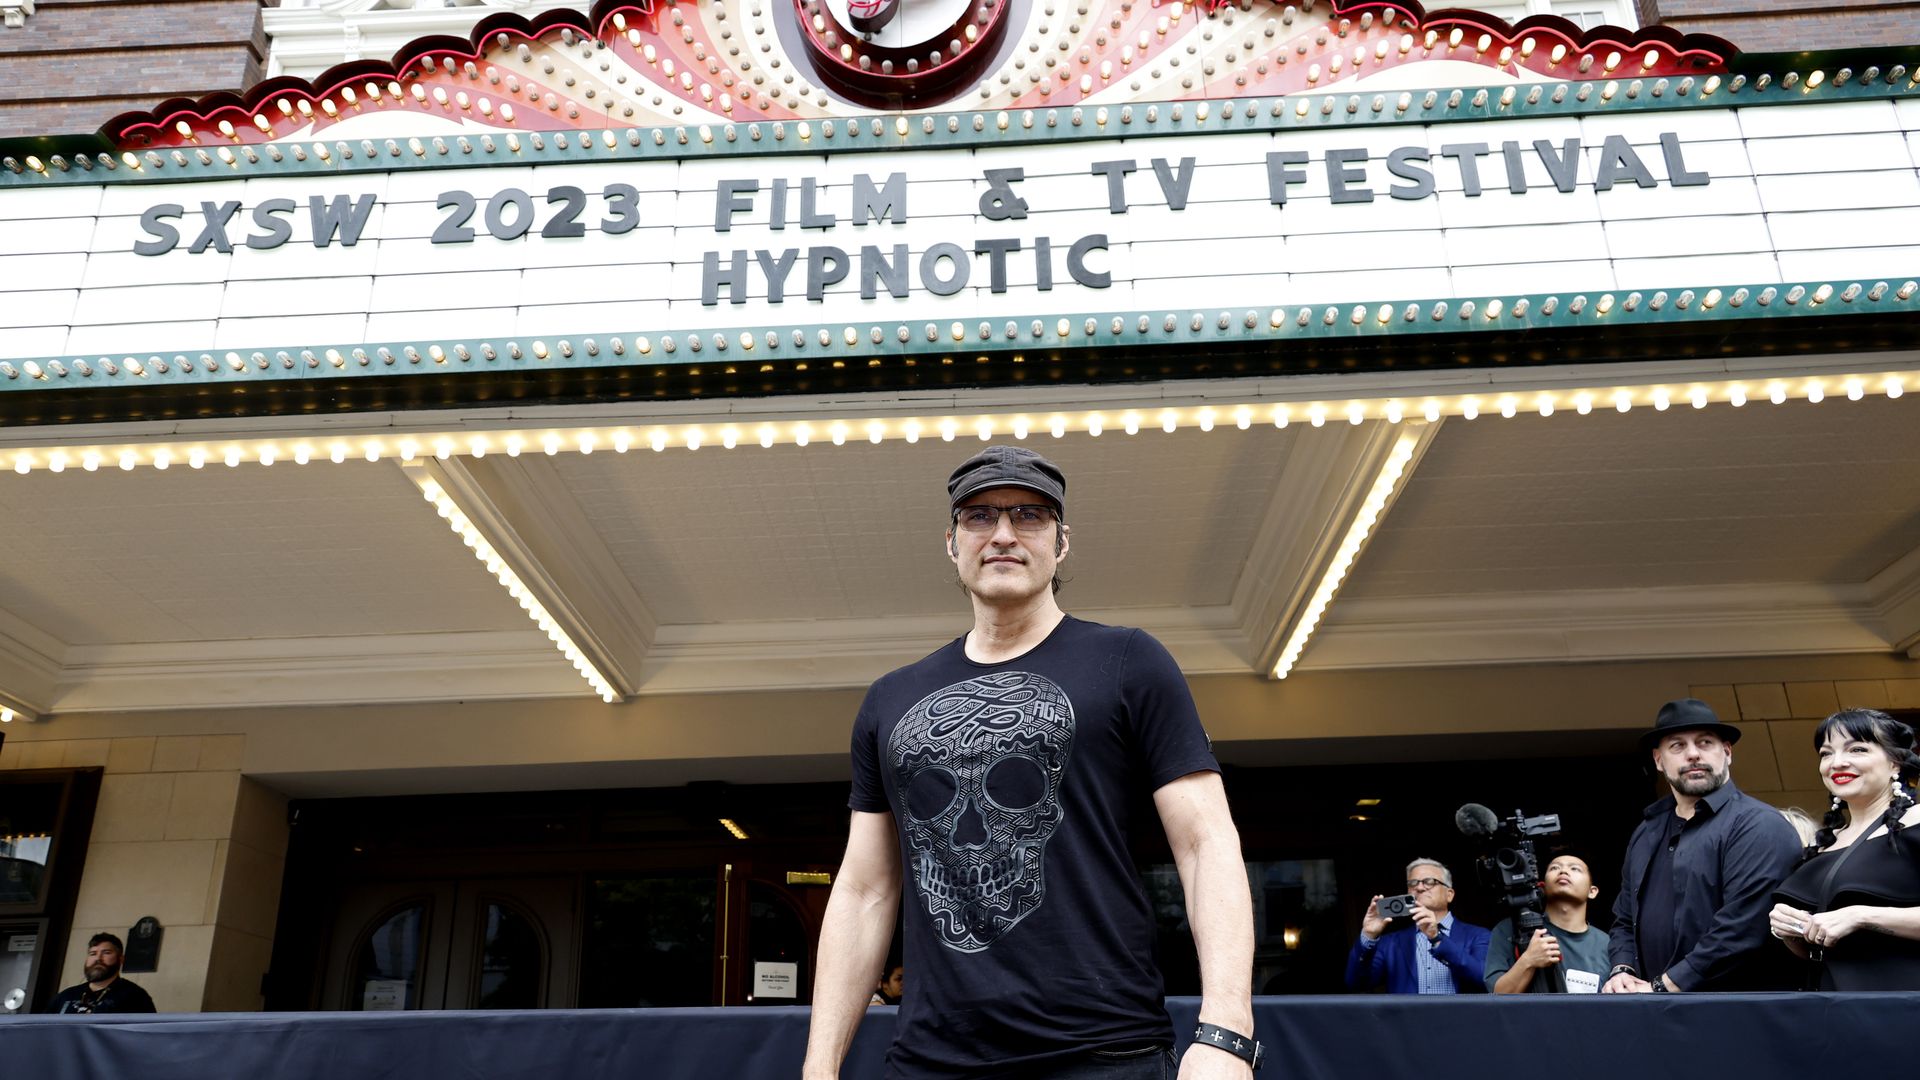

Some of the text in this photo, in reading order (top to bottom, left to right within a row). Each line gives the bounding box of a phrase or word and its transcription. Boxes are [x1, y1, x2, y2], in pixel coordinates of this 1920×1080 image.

[133, 132, 1711, 256] SXSW 2023 FILM & TV FESTIVAL
[701, 233, 1112, 306] HYPNOTIC
